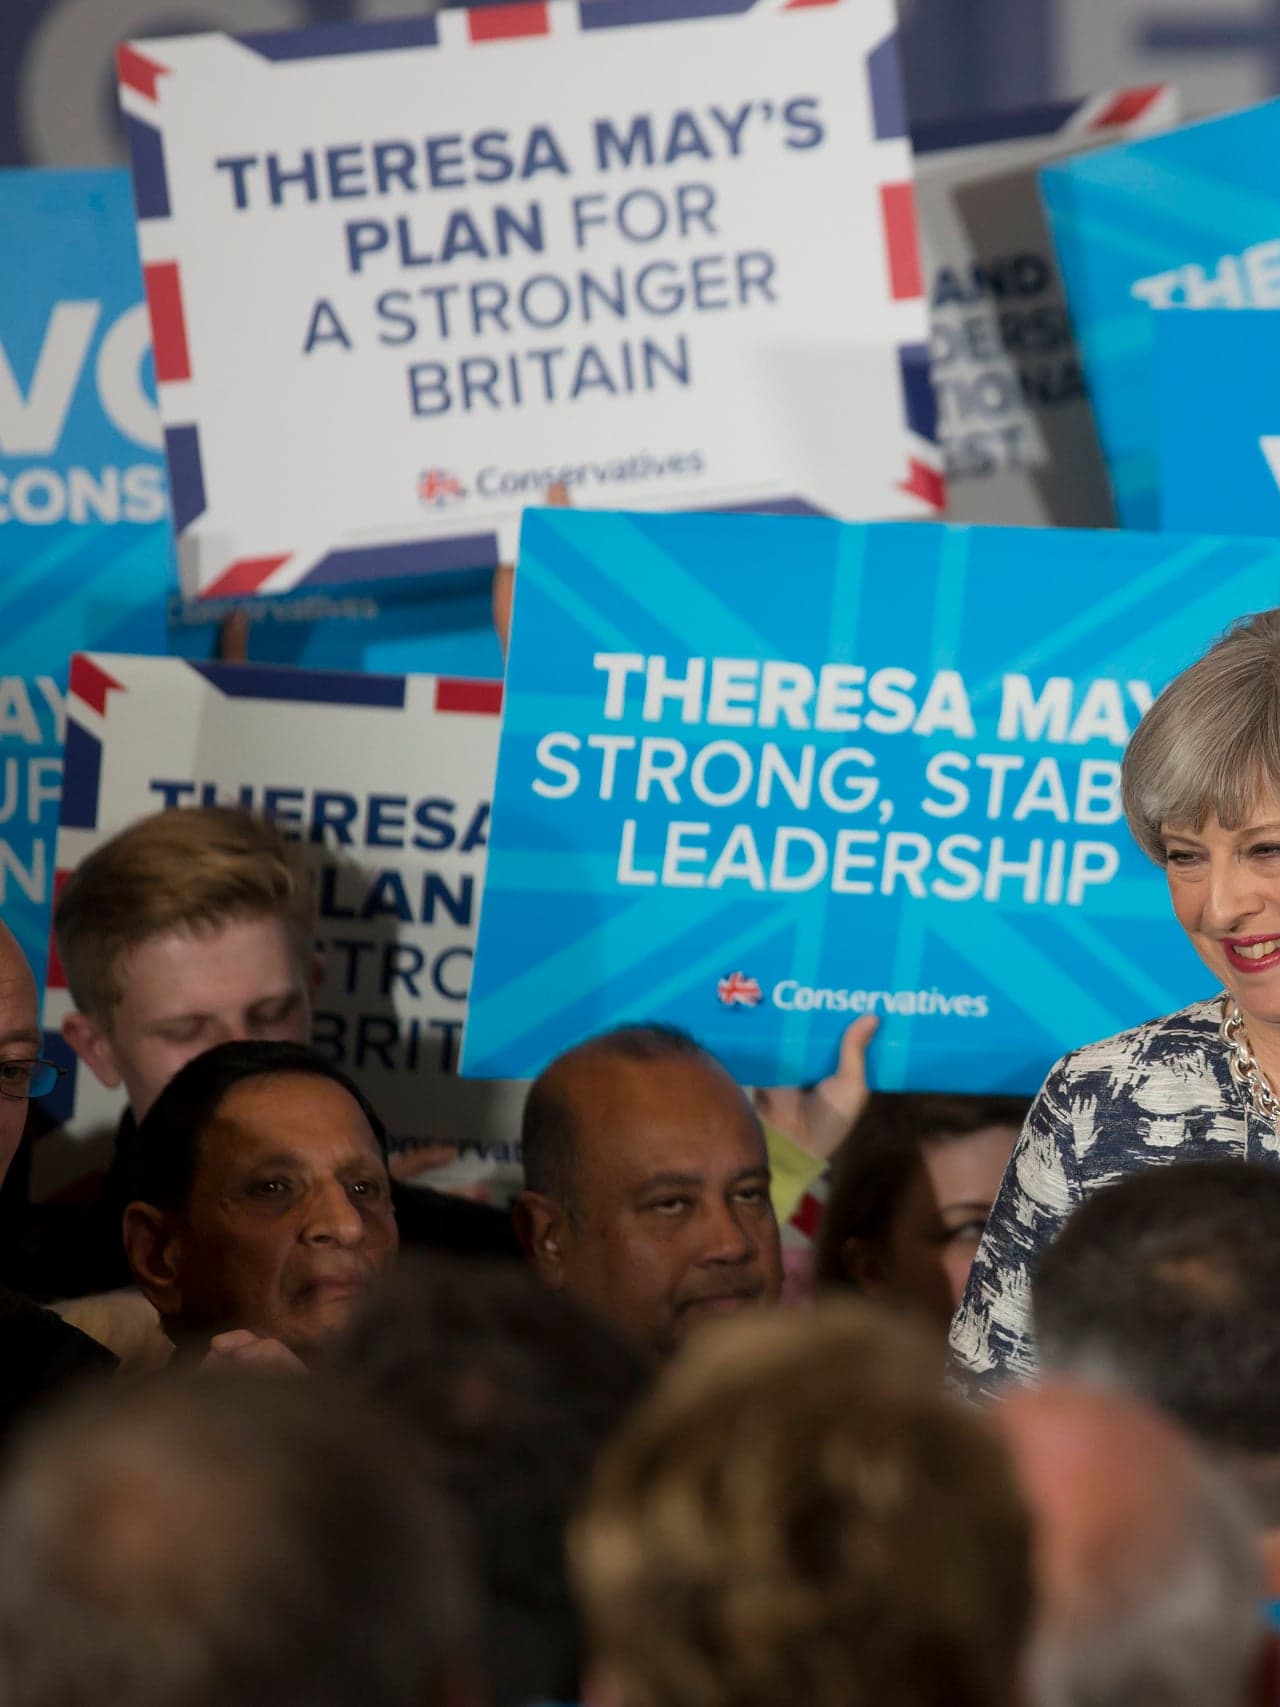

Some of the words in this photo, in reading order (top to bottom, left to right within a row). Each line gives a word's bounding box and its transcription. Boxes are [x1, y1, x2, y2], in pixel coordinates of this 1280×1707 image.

[215, 126, 571, 212] THERESA
[593, 96, 827, 174] MAY’S
[346, 202, 546, 275] PLAN
[571, 183, 718, 250] FOR
[303, 298, 352, 356] A
[374, 251, 778, 347] STRONGER
[407, 334, 691, 419] BRITAIN
[0, 463, 167, 526] ONS
[475, 450, 704, 497] Conservatives
[593, 652, 977, 740] THERESA
[532, 731, 895, 825] STRONG,
[921, 751, 1123, 826] STAB
[616, 819, 1121, 906] LEADERSHIP
[314, 938, 475, 1002] TRO
[771, 979, 990, 1018] Conservatives
